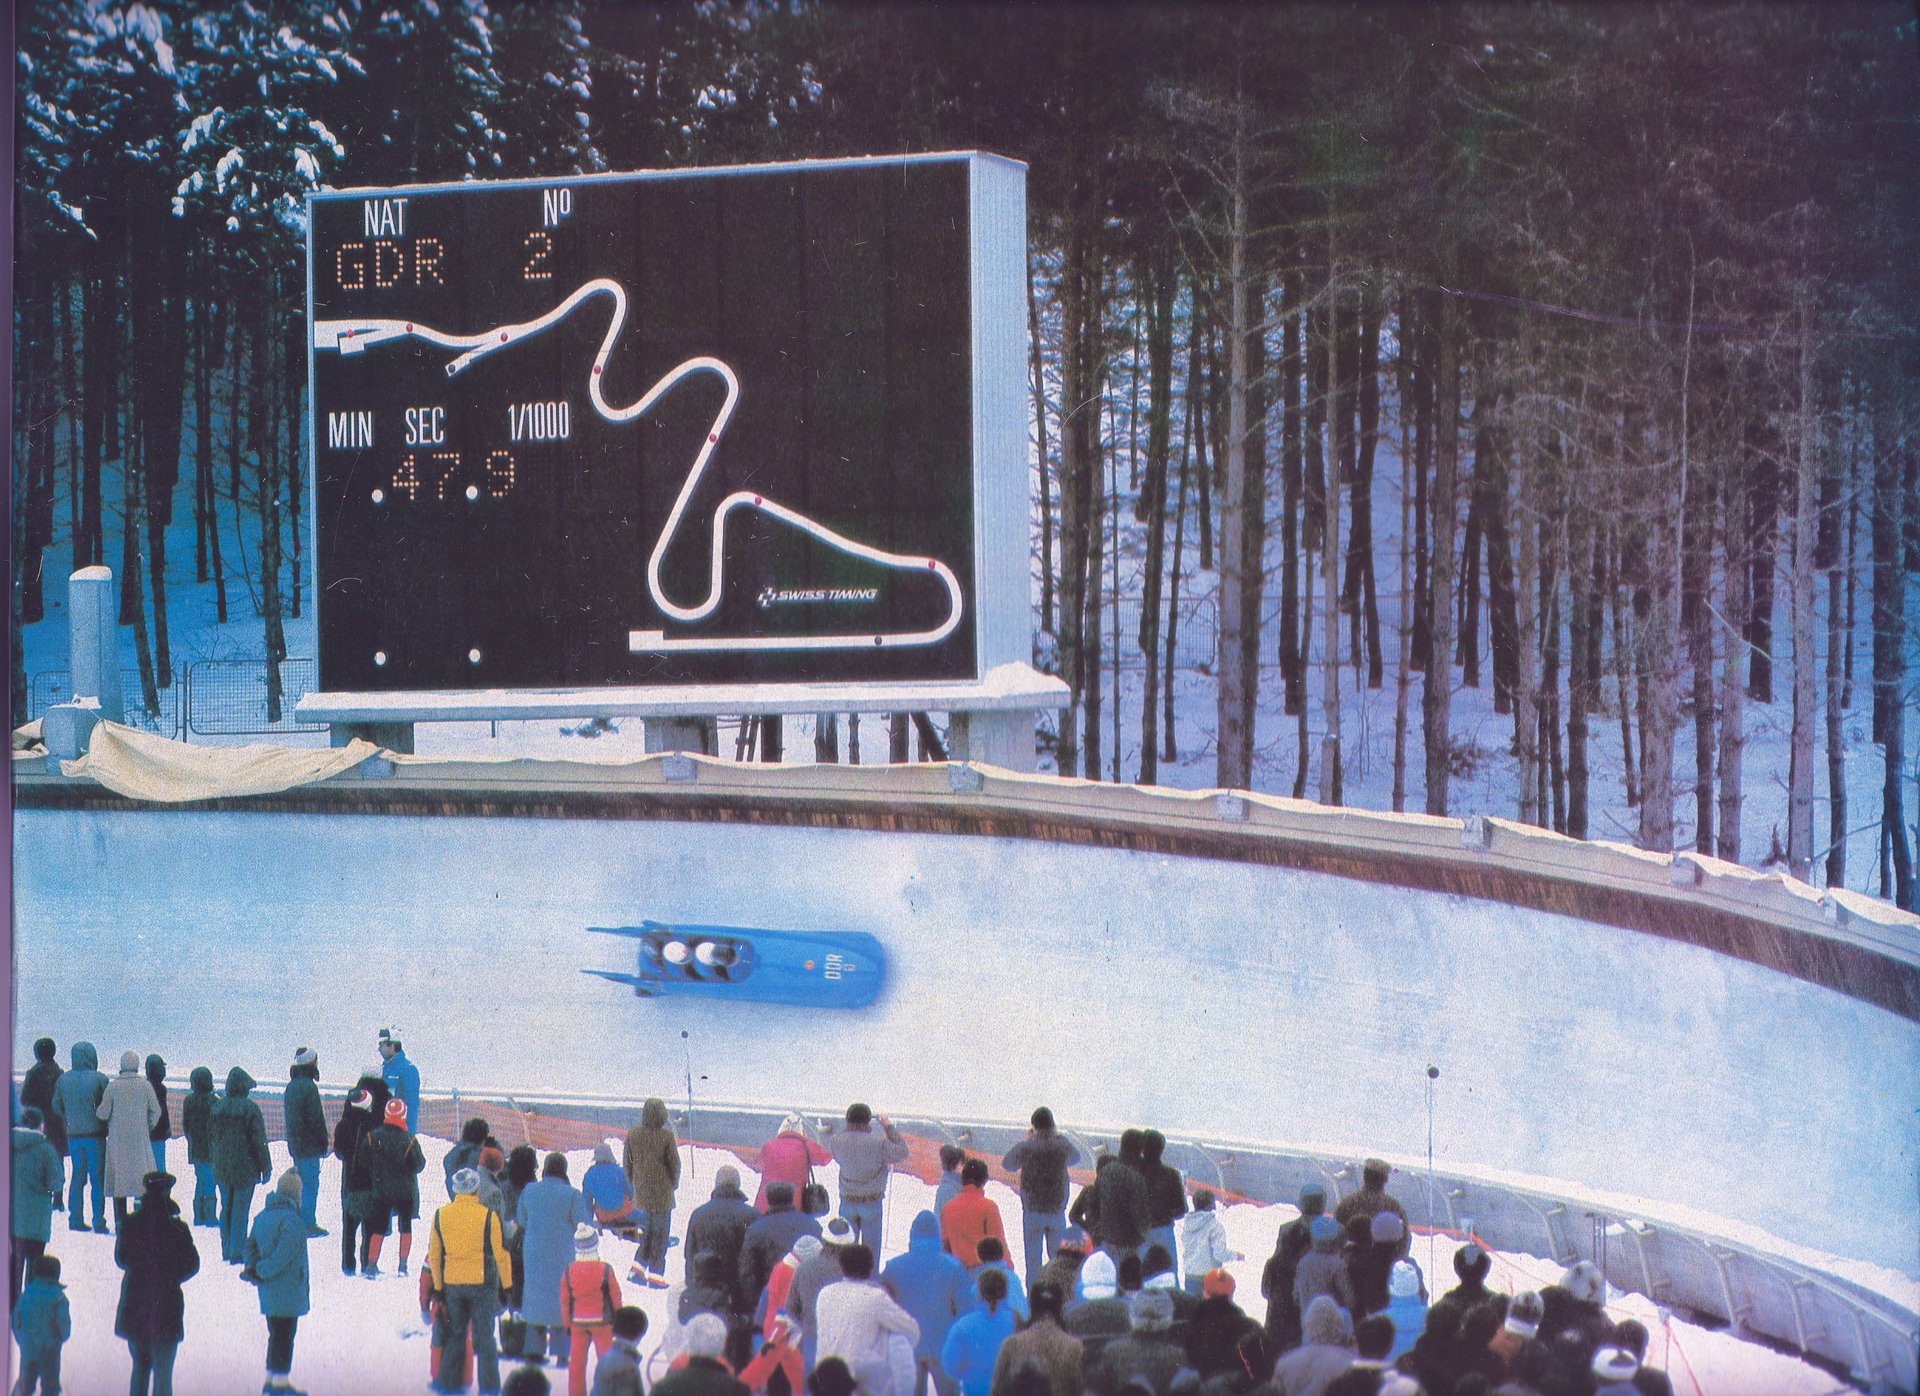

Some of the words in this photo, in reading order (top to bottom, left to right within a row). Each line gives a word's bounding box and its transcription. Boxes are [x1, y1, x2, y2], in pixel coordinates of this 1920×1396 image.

[364, 198, 408, 237] NAT
[336, 238, 444, 289] GDR
[524, 231, 552, 279] 2
[328, 411, 372, 448] MIN
[405, 406, 444, 444] SEC
[508, 401, 570, 440] 1/1000
[777, 589, 826, 601] SWISS
[828, 588, 878, 601] TIMING
